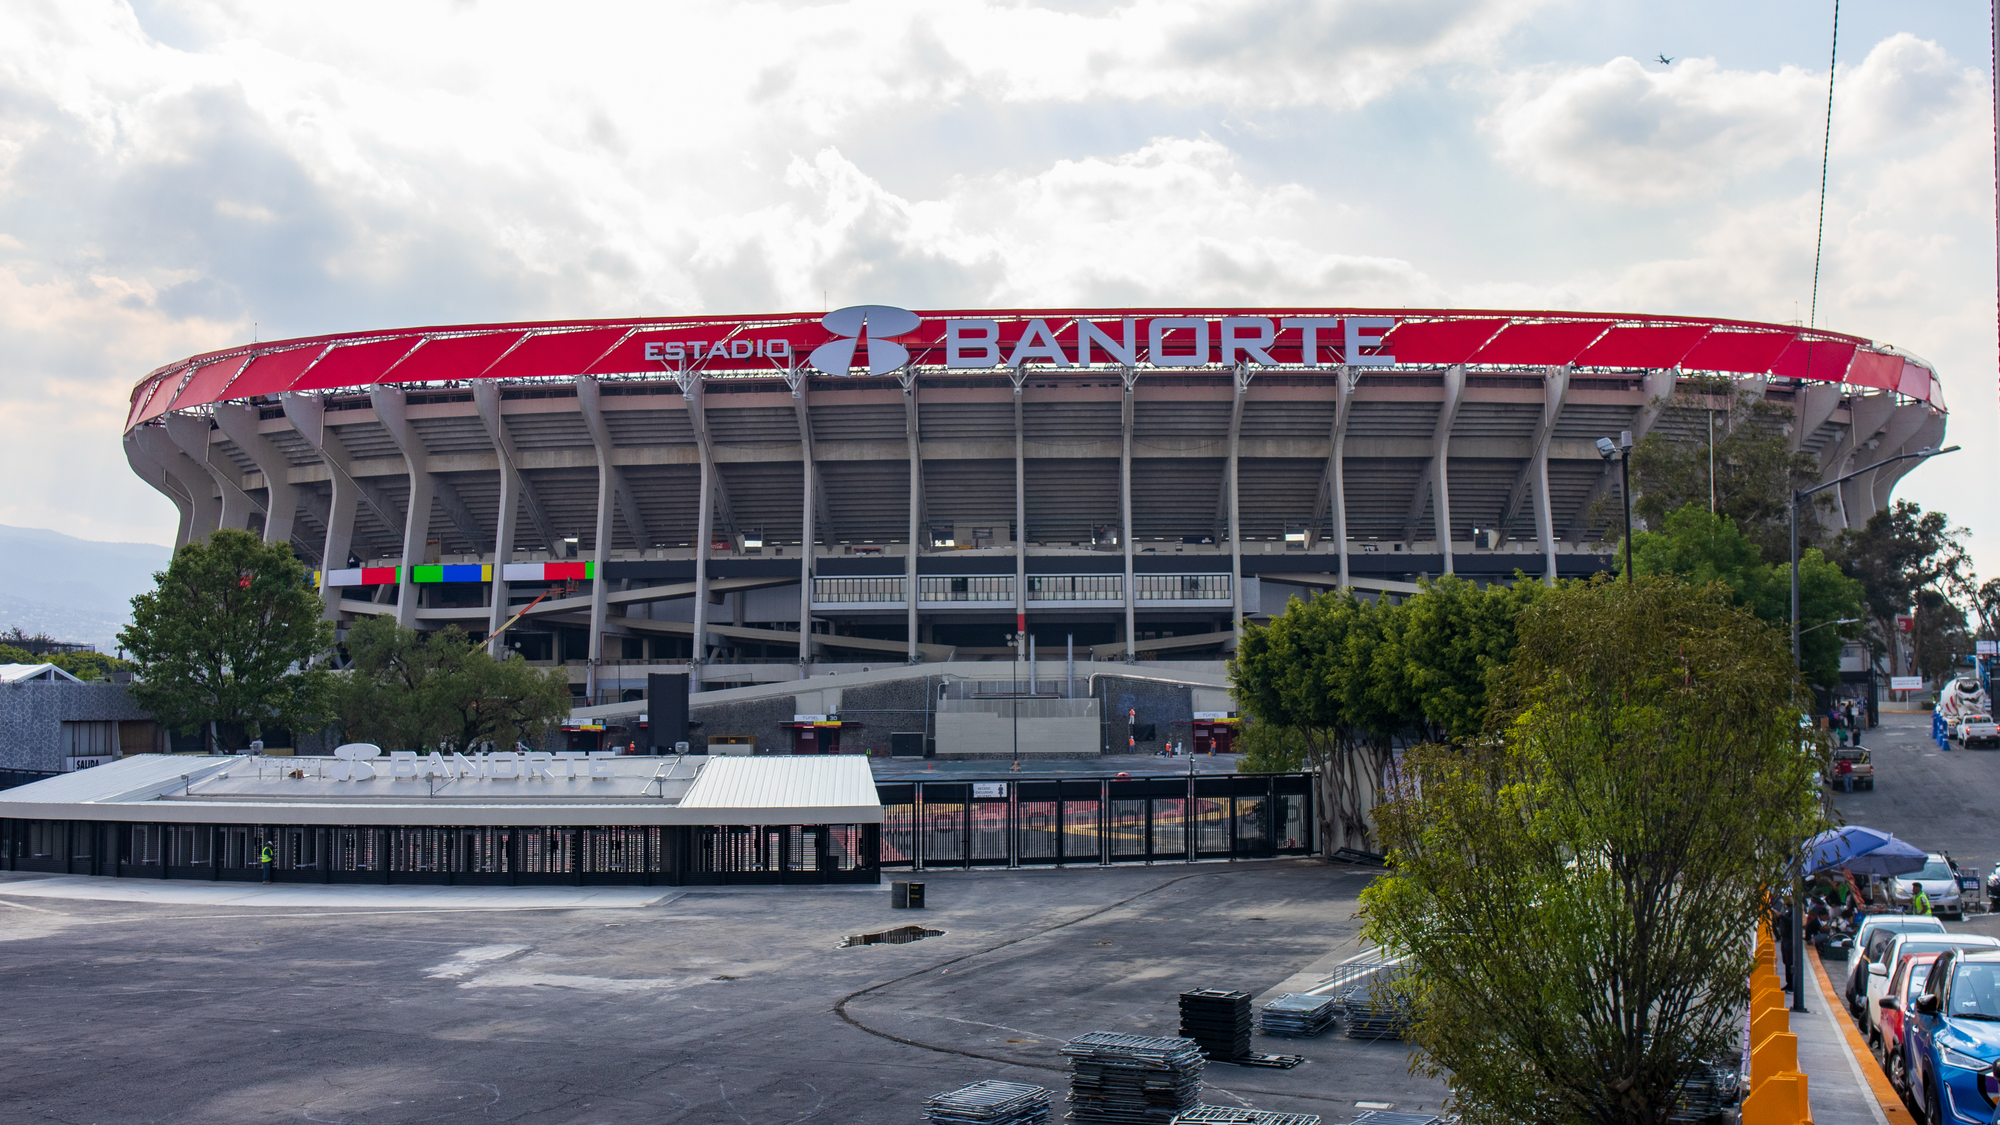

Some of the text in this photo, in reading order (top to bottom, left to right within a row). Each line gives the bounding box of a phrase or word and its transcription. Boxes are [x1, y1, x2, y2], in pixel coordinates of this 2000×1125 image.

[644, 317, 1396, 369] ESTADIO BANORTE
[76, 759, 99, 769] SALIDA
[390, 751, 616, 779] BANORTE
